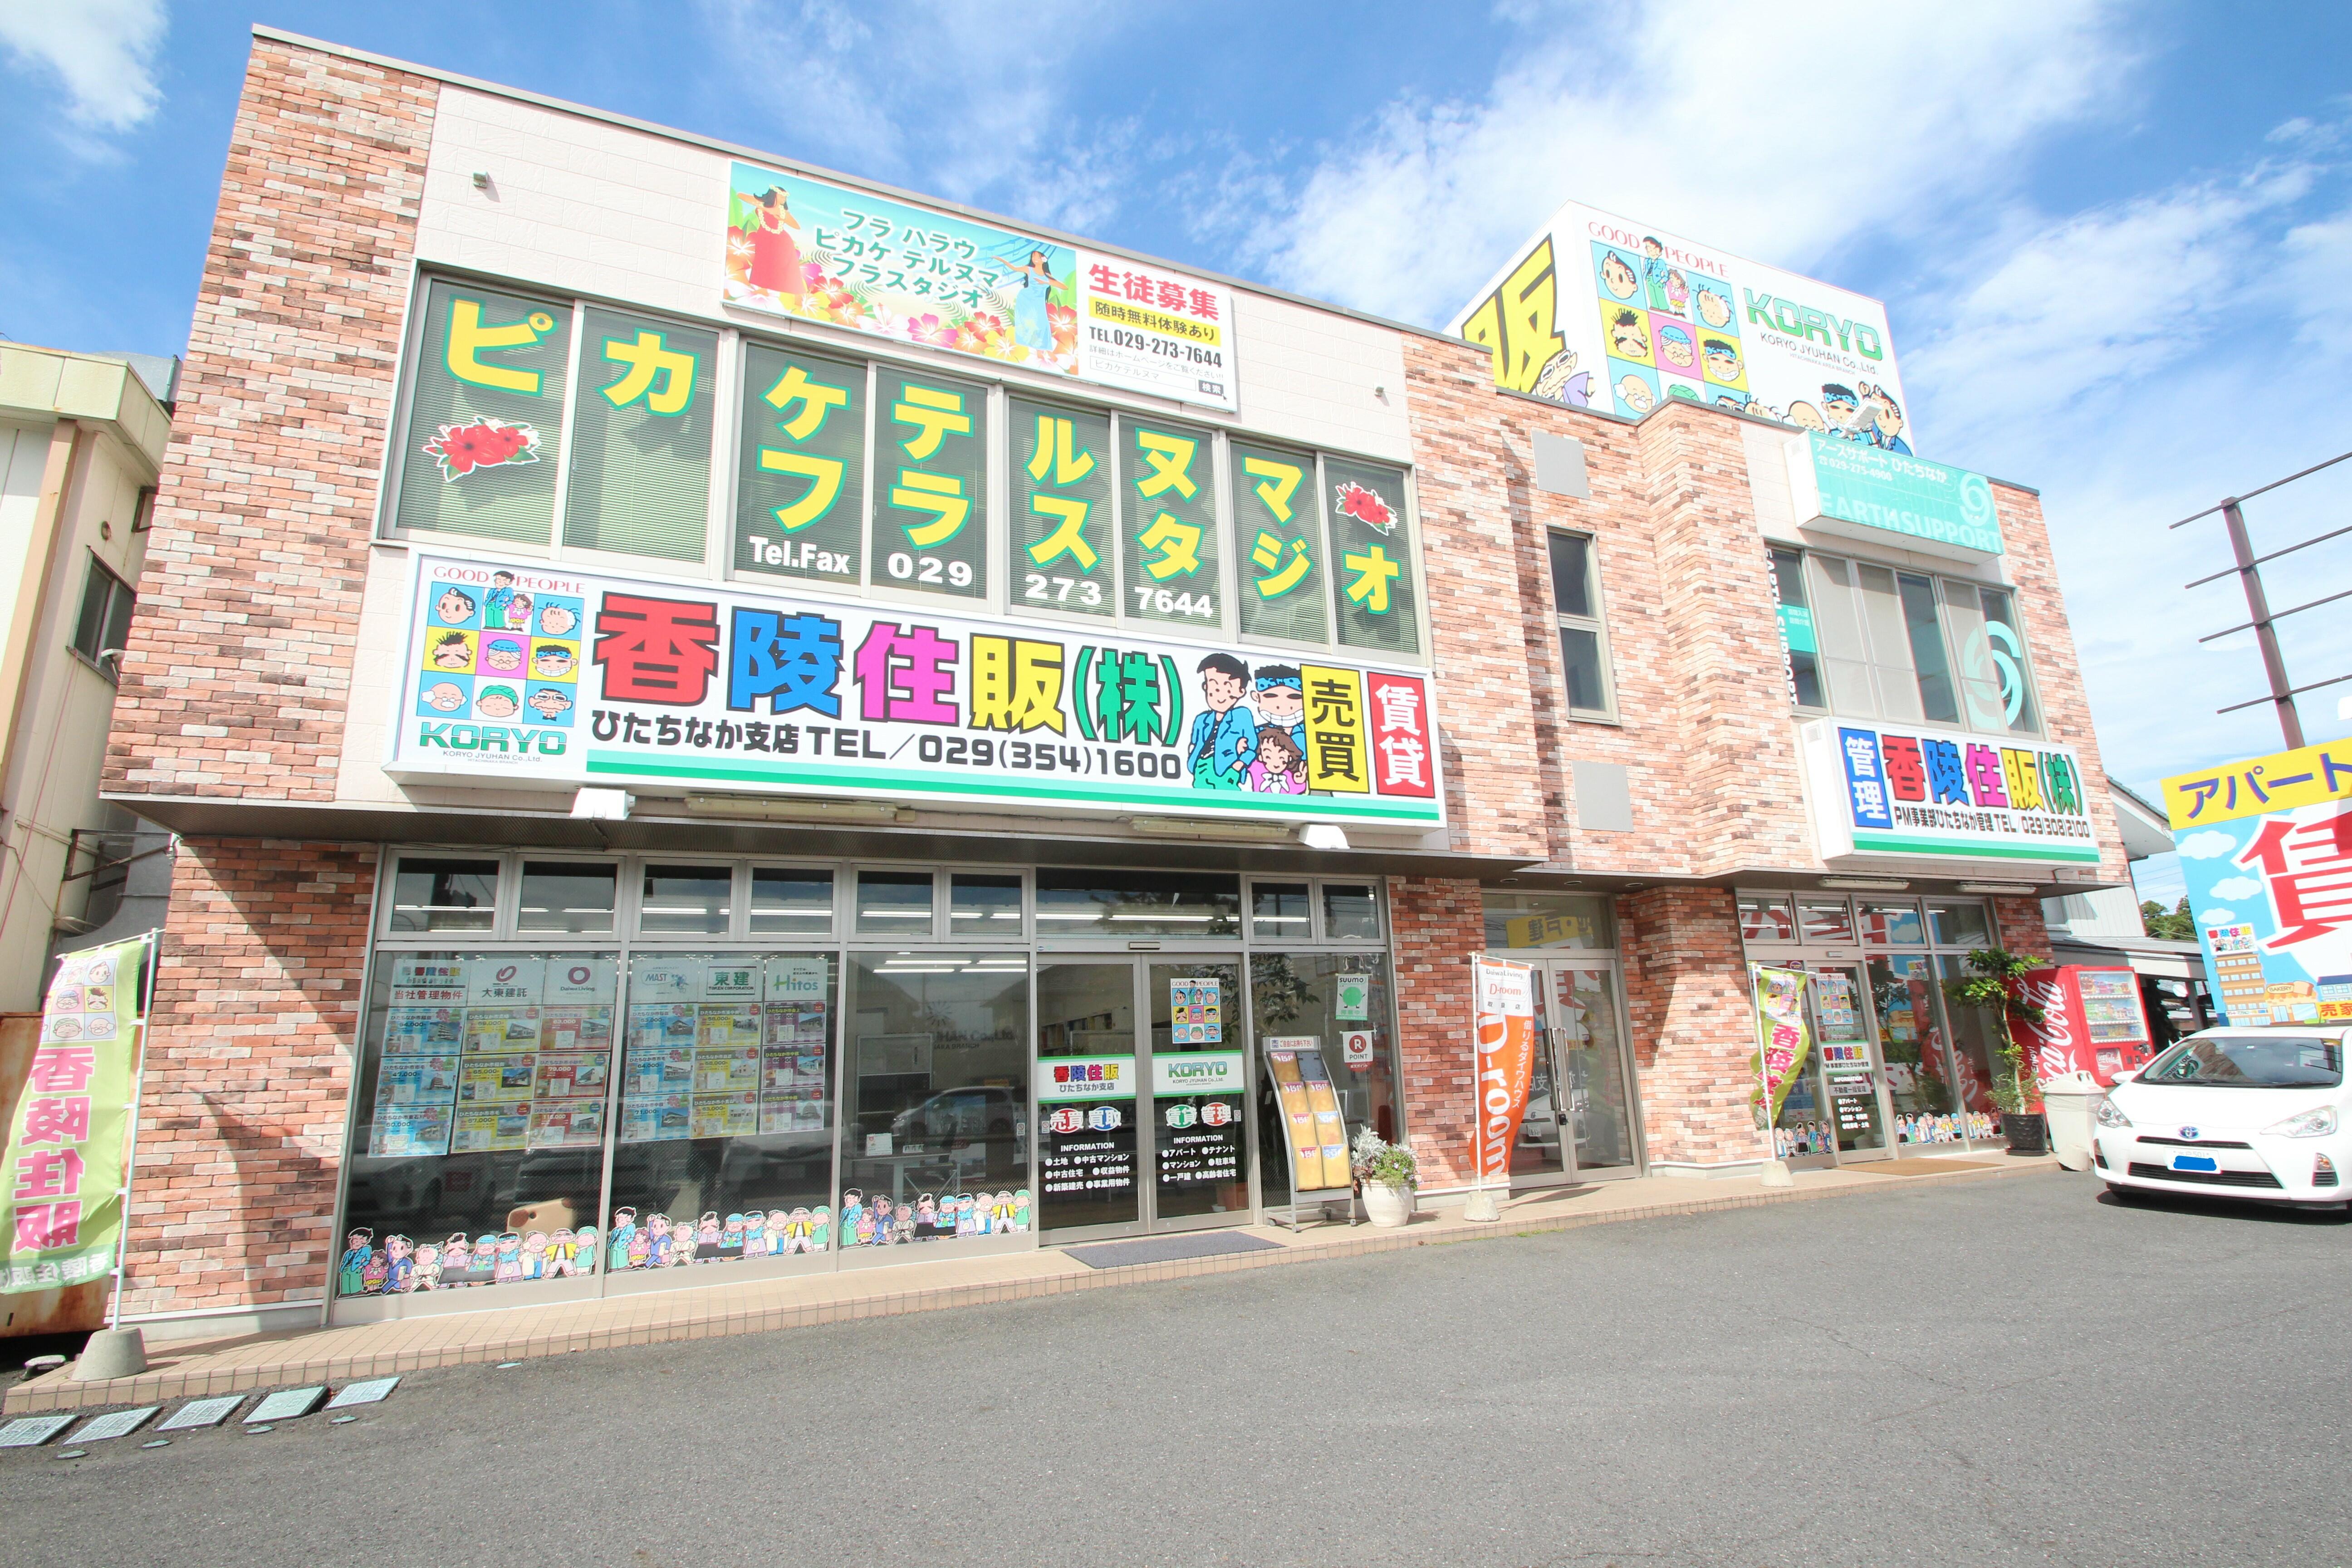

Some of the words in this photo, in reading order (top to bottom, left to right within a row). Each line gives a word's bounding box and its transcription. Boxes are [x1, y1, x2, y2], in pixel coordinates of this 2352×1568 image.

[843, 211, 891, 238] フラ
[902, 228, 975, 260] ハラウ
[1588, 221, 1641, 250] GOOD
[1662, 247, 1730, 278] PEOPLE
[816, 228, 892, 261] ピカケ
[902, 250, 1000, 288] テルヌマ
[833, 257, 983, 309] フラスタジオ
[1089, 263, 1220, 321] 生徒募集
[1095, 301, 1215, 341] 随時無料体験あり
[1743, 287, 1883, 361] KORYO
[1760, 332, 1797, 351] KORYO
[1800, 344, 1840, 364] JYUHAN
[1836, 365, 1856, 376] BRANCH
[1202, 382, 1221, 395] 検索
[1814, 438, 1888, 468] アースサポート
[1891, 457, 1947, 484] ひたちなか
[434, 566, 490, 583] GOOD
[515, 575, 586, 594] PEOPLE
[749, 535, 851, 574] Tel.Fax
[887, 551, 973, 587] 029
[1024, 573, 1102, 606] 273
[1133, 586, 1214, 618] 7644
[592, 590, 1185, 748] 香陵住販(株)
[419, 721, 568, 756] KORYO
[1310, 678, 1361, 781] 売買
[1375, 681, 1427, 789] 賃貸
[442, 750, 473, 759] KORYO
[475, 752, 510, 760] JYUHAN
[1845, 736, 1887, 820] 管理
[1881, 734, 2083, 817] 香陵住販(株)
[645, 973, 668, 982] MAST
[714, 971, 750, 986] 東建
[773, 974, 818, 991] Hitos
[394, 990, 463, 1000] 当社管理物件
[481, 987, 528, 998] 大東建託
[1354, 1039, 1363, 1050] R
[1054, 1063, 1119, 1083] 香陵住販
[1168, 1061, 1228, 1078] KORYO
[1512, 1019, 1533, 1108] 借りるダイワハウス
[2027, 1045, 2040, 1073] Enjoy!
[1059, 1082, 1115, 1093] ひたちなか支店
[1049, 1110, 1084, 1131] 売買
[1088, 1109, 1122, 1129] 買取
[1165, 1106, 1198, 1127] 賃貸
[1200, 1105, 1233, 1124] 管理
[1060, 1142, 1115, 1152] INFORMATION
[1173, 1134, 1224, 1144] INFORMATION
